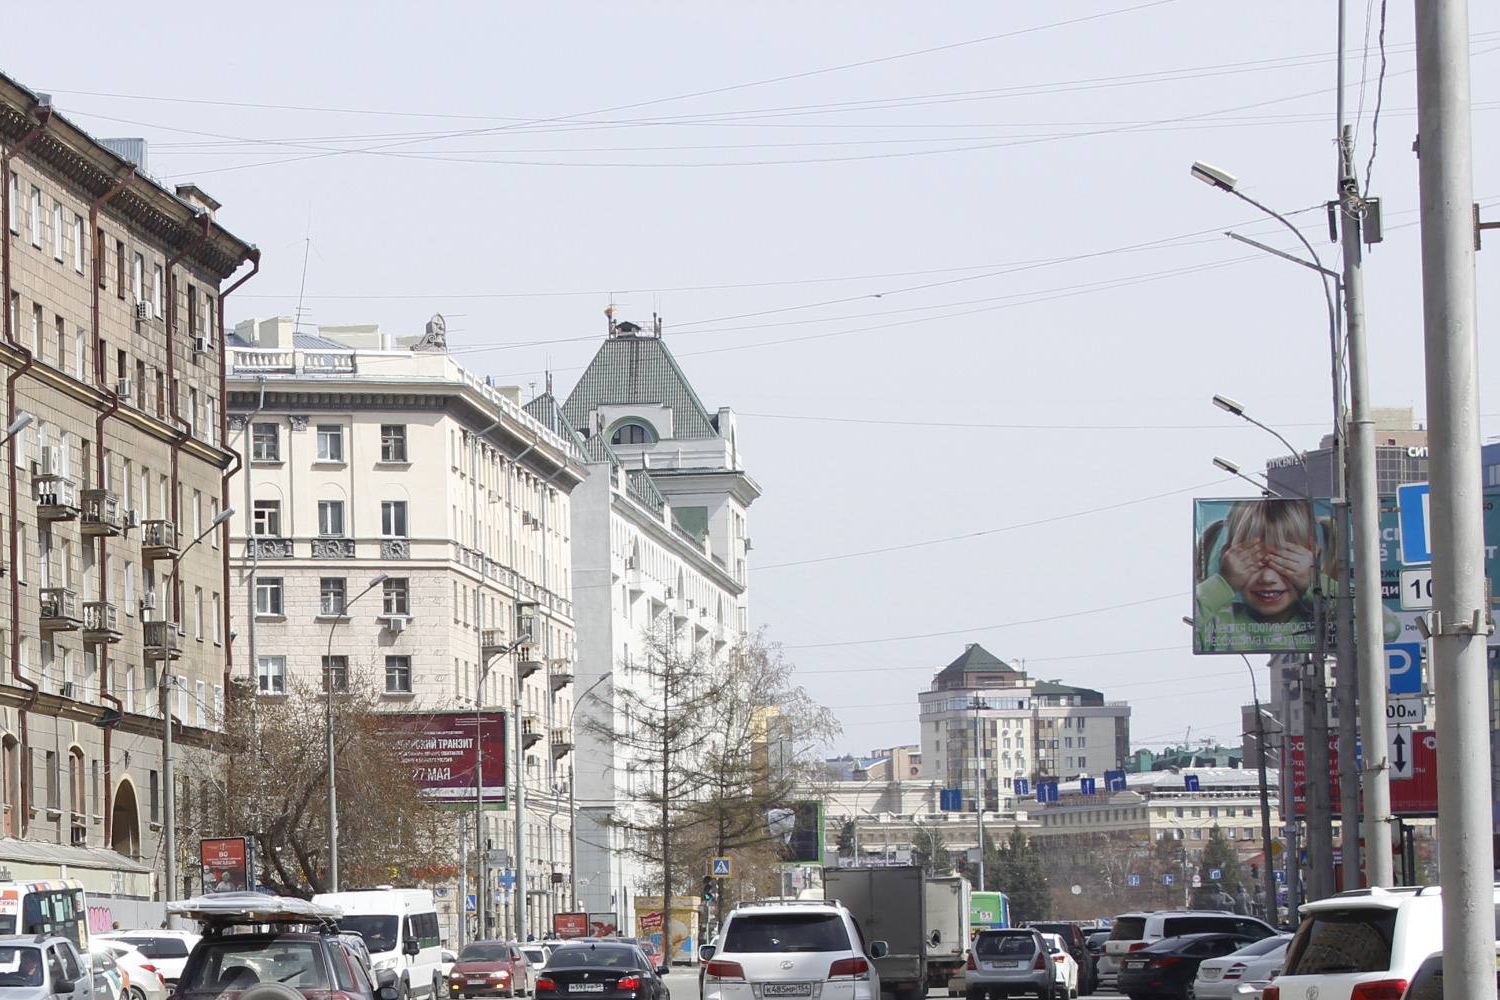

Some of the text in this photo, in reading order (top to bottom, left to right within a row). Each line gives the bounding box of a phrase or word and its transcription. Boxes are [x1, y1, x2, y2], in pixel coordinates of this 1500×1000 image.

[438, 738, 474, 749] ТРАНЗИТ
[427, 767, 451, 781] МАЯ
[981, 911, 991, 919] 51
